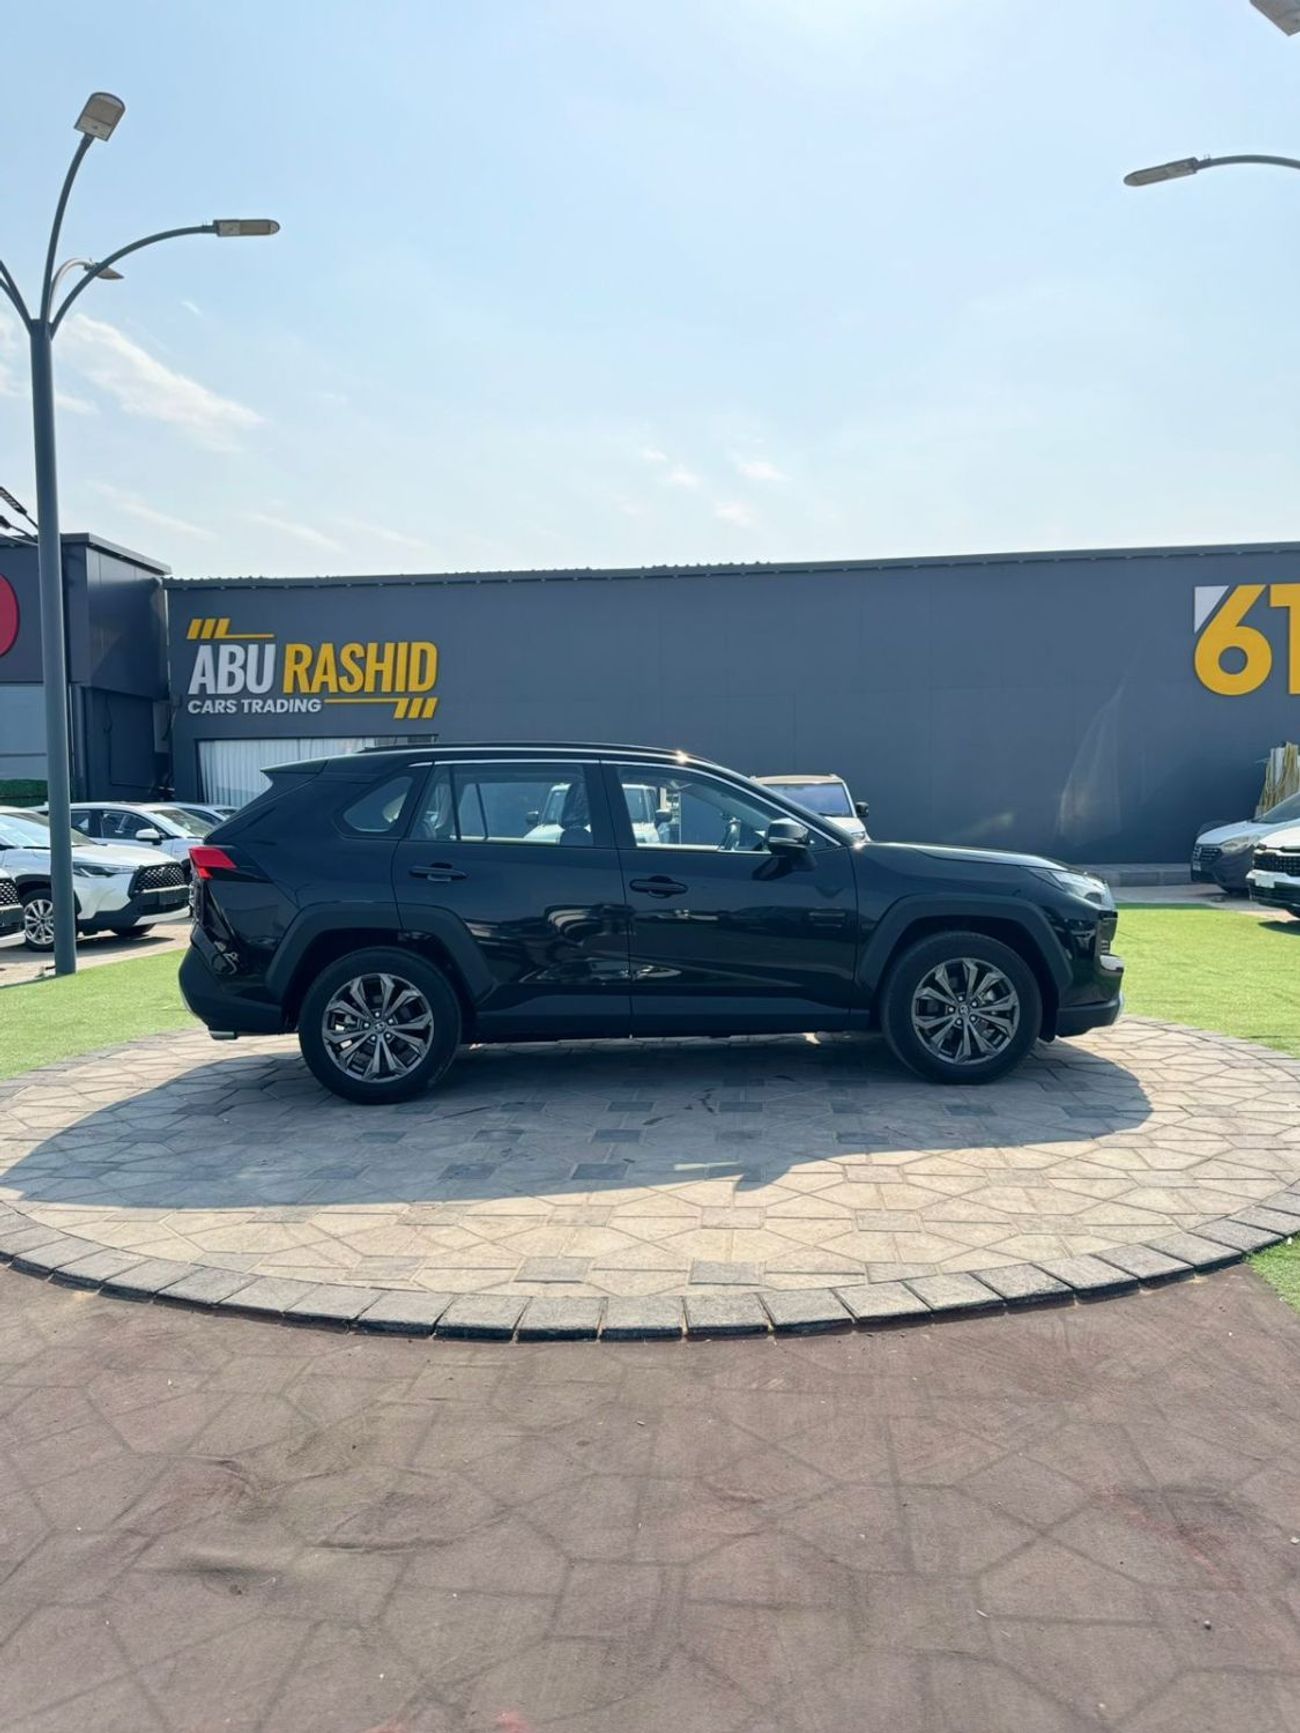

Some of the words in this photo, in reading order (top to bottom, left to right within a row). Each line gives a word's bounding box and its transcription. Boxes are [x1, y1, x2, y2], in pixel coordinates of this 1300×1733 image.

[188, 644, 276, 695] ABU
[282, 641, 438, 694] RASHID
[187, 699, 237, 714] CARS
[242, 698, 322, 713] TRADING
